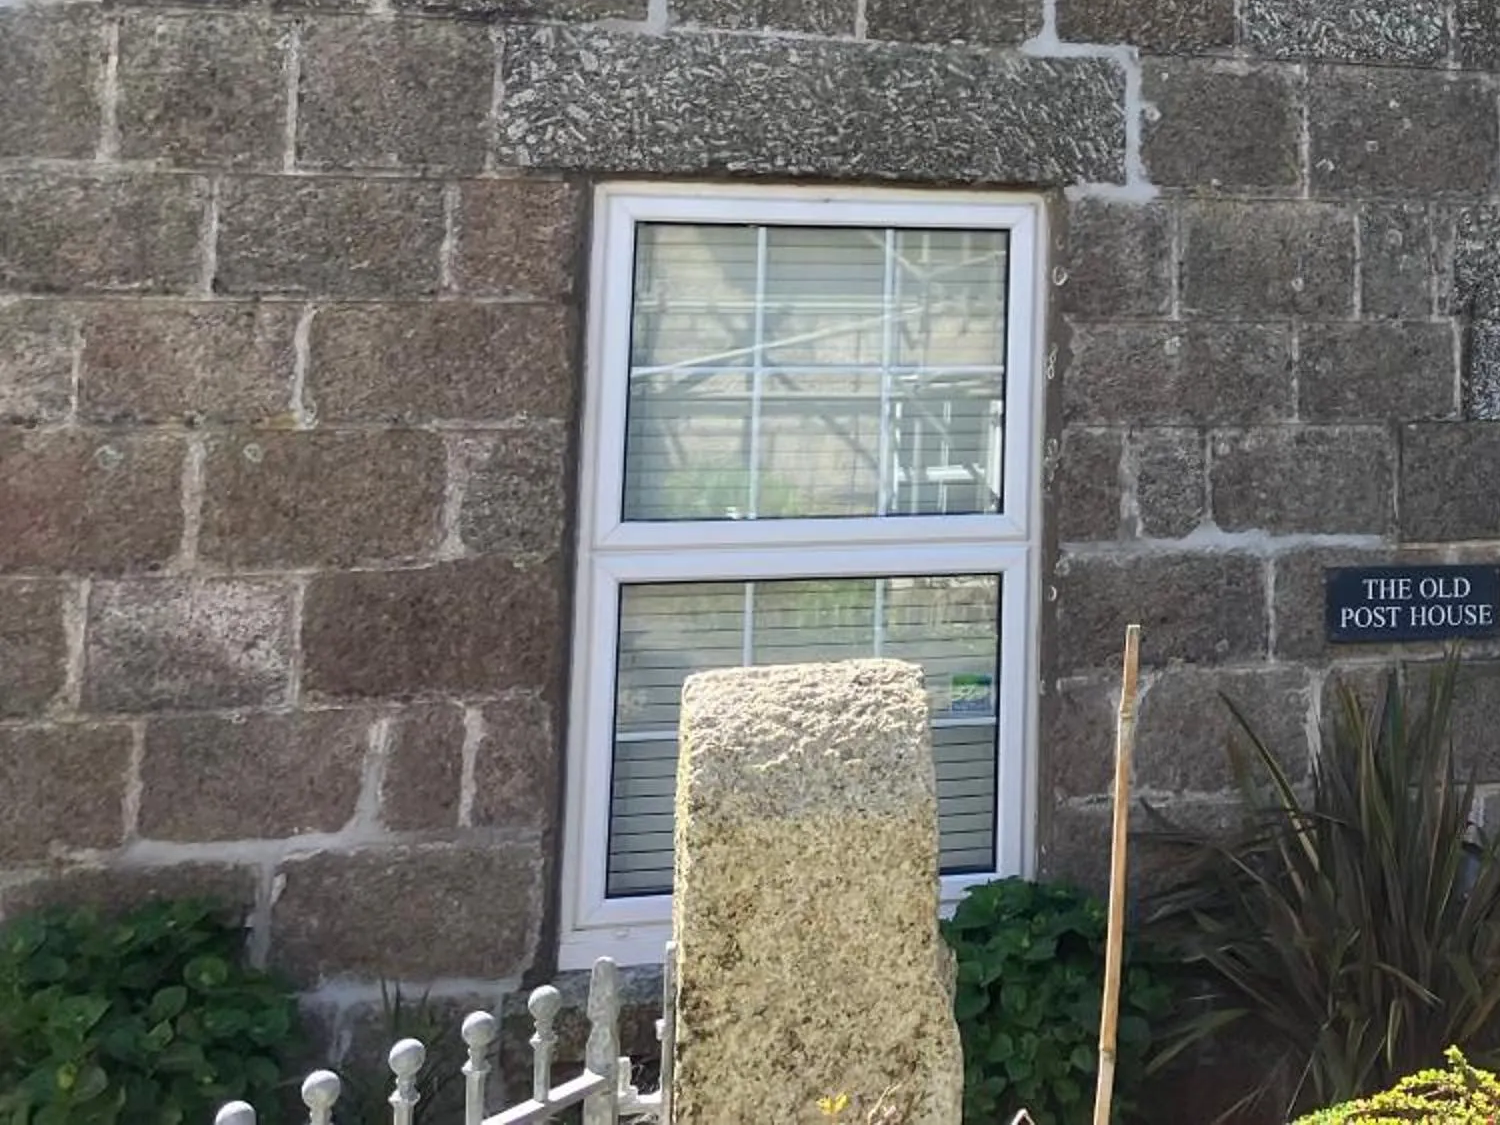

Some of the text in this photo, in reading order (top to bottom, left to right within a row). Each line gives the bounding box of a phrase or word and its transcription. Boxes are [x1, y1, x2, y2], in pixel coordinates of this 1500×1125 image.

[1362, 577, 1471, 600] THE OLD
[1340, 604, 1493, 628] POST HOUSE
